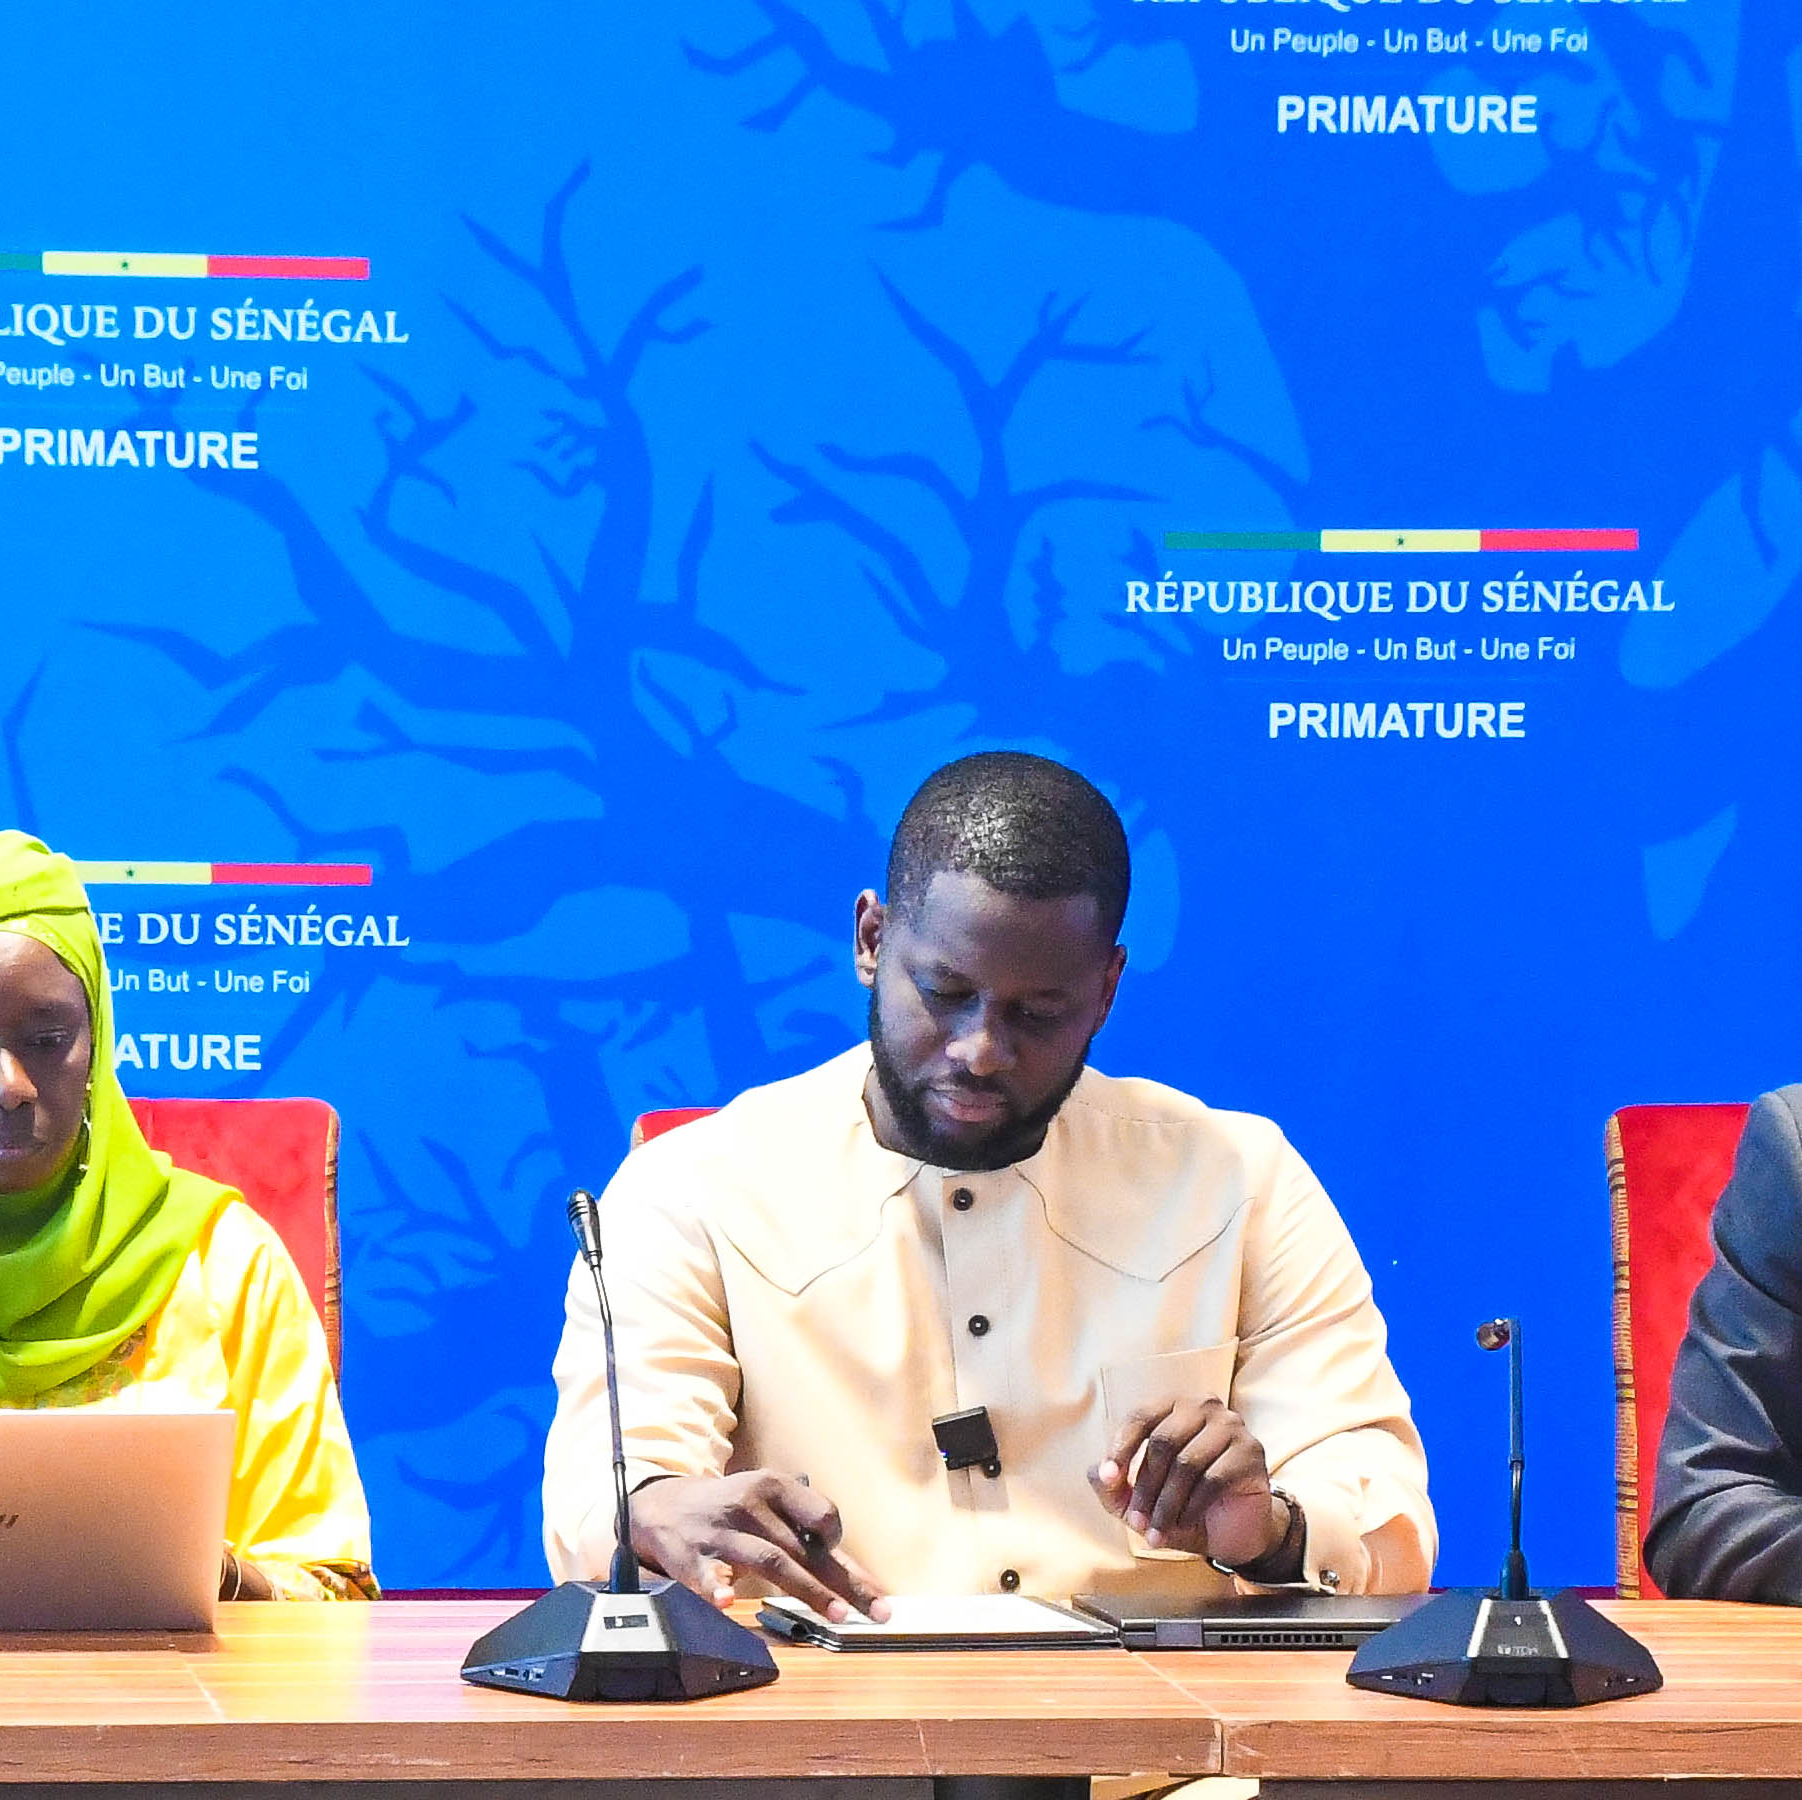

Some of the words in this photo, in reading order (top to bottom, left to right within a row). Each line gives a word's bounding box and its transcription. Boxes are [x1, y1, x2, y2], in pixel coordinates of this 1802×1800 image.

[1232, 29, 1265, 52] Un
[1274, 28, 1358, 57] Peuple
[1385, 29, 1417, 52] Un
[1427, 28, 1467, 52] But
[1493, 29, 1541, 53] Une
[1551, 28, 1587, 52] Foi
[1278, 96, 1537, 133] PRIMATURE
[135, 307, 196, 339] DU
[211, 298, 408, 342] SÉNÉGAL
[101, 364, 135, 386] Un
[144, 364, 185, 388] But
[211, 366, 261, 389] Une
[270, 366, 307, 390] Foi
[1126, 571, 1393, 620] RÉPUBLIQUE
[1407, 582, 1469, 612] DU
[1483, 571, 1675, 612] SÉNÉGAL
[1224, 638, 1256, 660] Un
[1266, 638, 1348, 665] Peuple
[1375, 639, 1407, 660] Un
[1416, 637, 1455, 660] But
[1482, 638, 1529, 660] Une
[1539, 637, 1575, 659] Foi
[1270, 703, 1525, 738] PRIMATURE
[138, 914, 200, 944] DU
[215, 904, 409, 946] SÉNÉGAL
[149, 969, 189, 992] But
[215, 970, 264, 992] Une
[274, 970, 309, 993] Foi
[115, 1033, 261, 1070] ATURE
